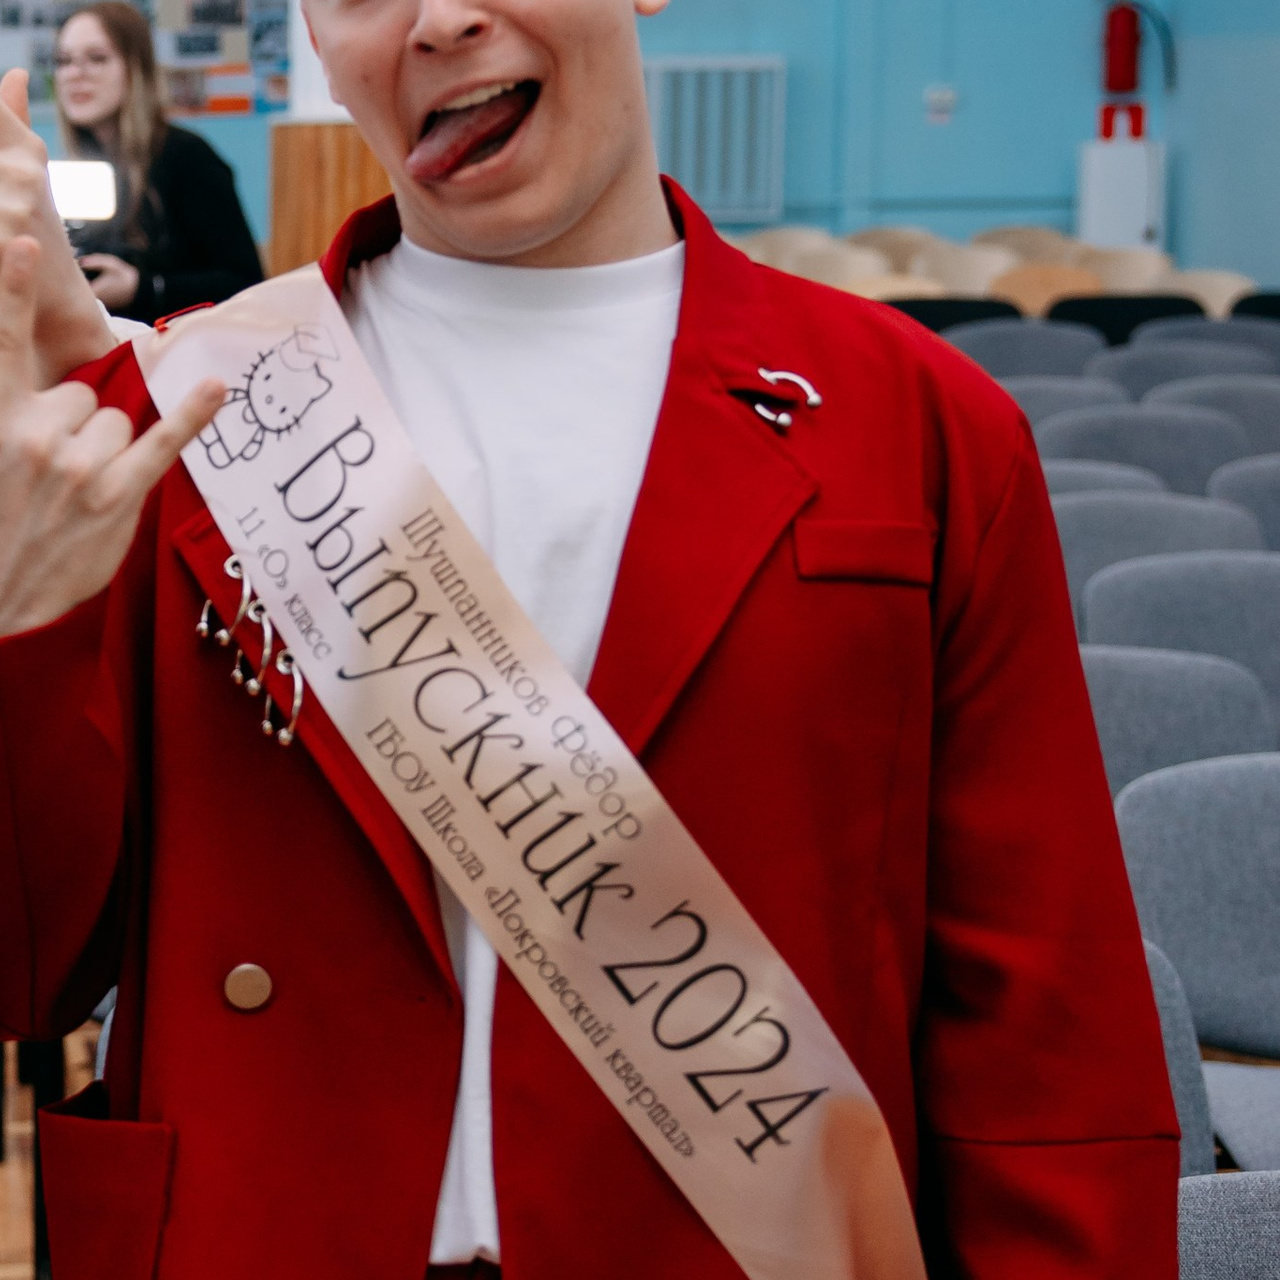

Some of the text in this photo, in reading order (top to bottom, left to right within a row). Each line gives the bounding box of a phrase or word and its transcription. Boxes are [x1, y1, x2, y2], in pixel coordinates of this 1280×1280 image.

[237, 506, 263, 541] 11
[282, 592, 335, 662] класс
[400, 508, 643, 843] Шушпанников Фёдор
[274, 415, 830, 1164] Выпускник 2024
[365, 717, 433, 796] ГБОУ
[421, 792, 485, 882] Школа
[484, 885, 614, 1050] «Покровский
